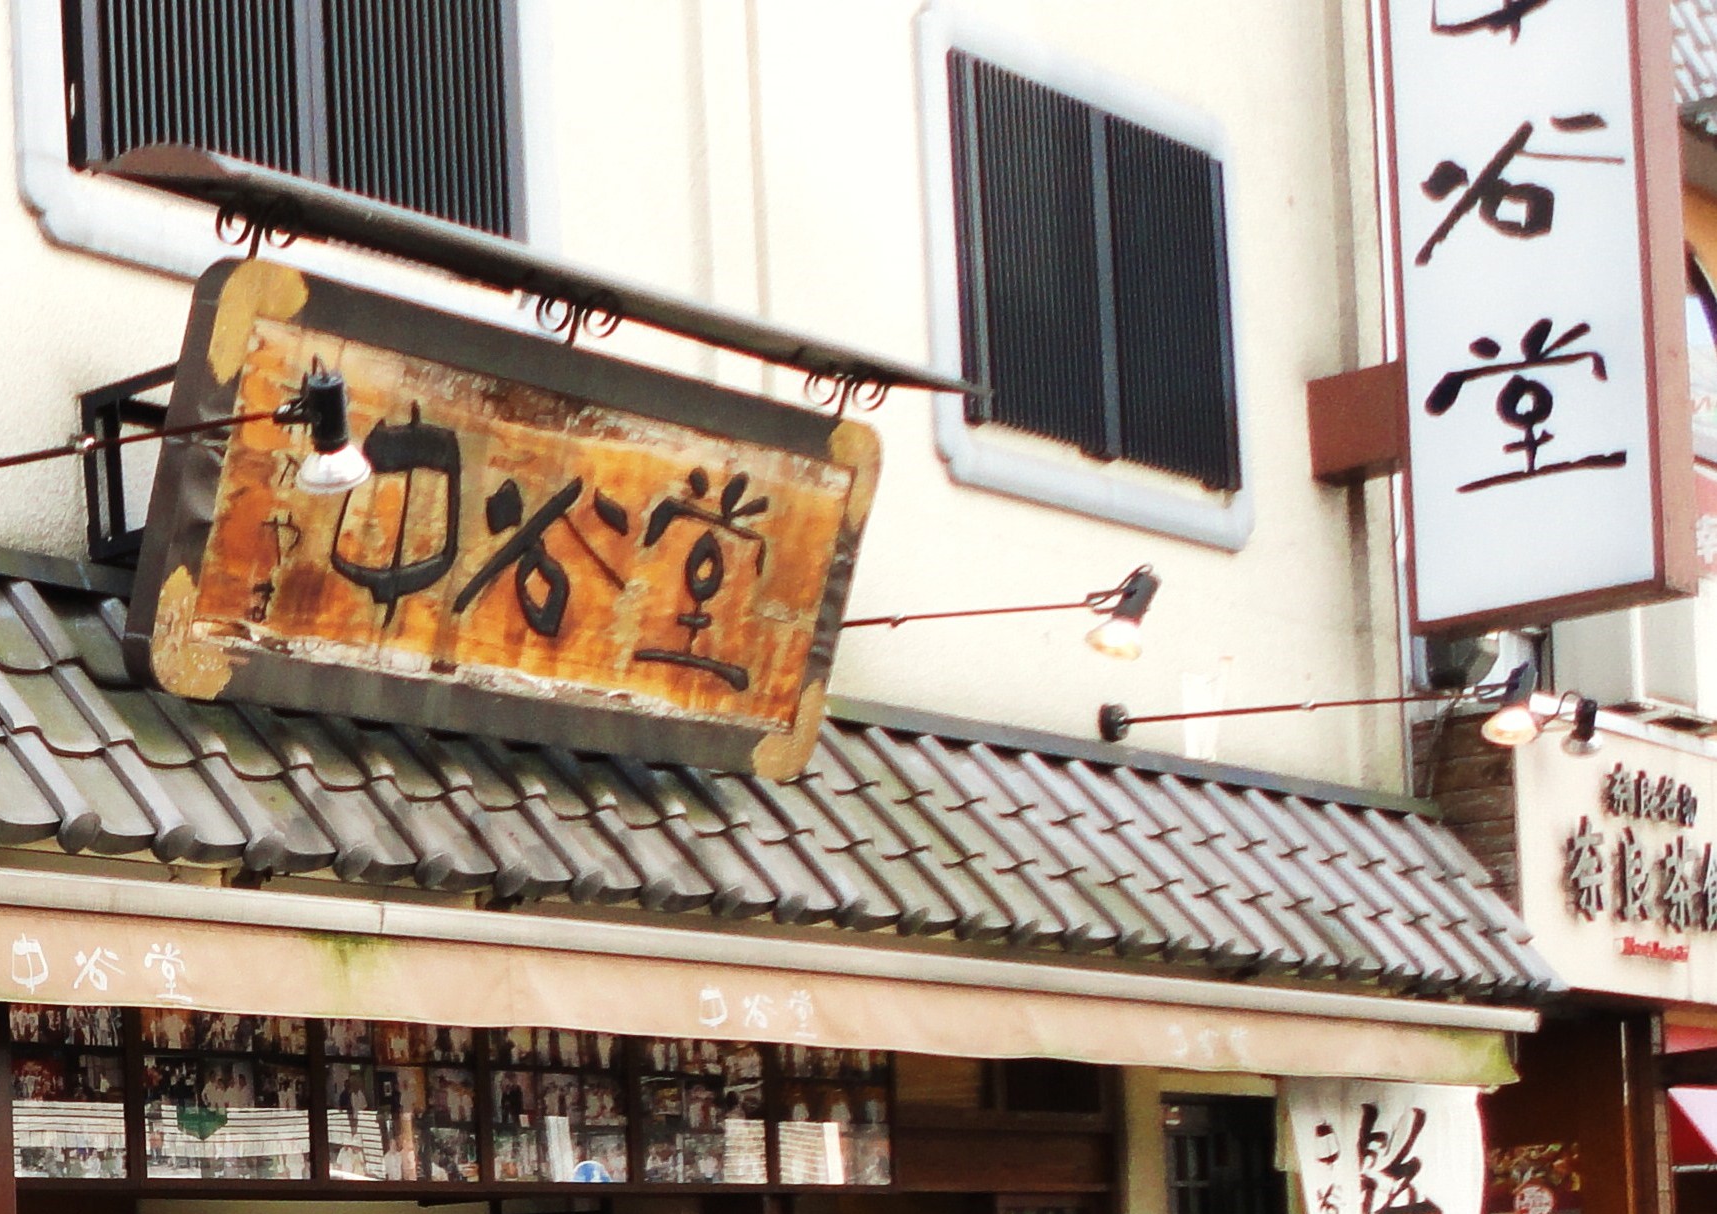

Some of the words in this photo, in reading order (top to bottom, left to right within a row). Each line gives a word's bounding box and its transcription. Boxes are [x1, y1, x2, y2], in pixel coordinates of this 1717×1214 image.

[1414, 0, 1626, 492] 谷堂
[330, 401, 768, 692] 中谷堂
[11, 932, 193, 1003] 中谷堂
